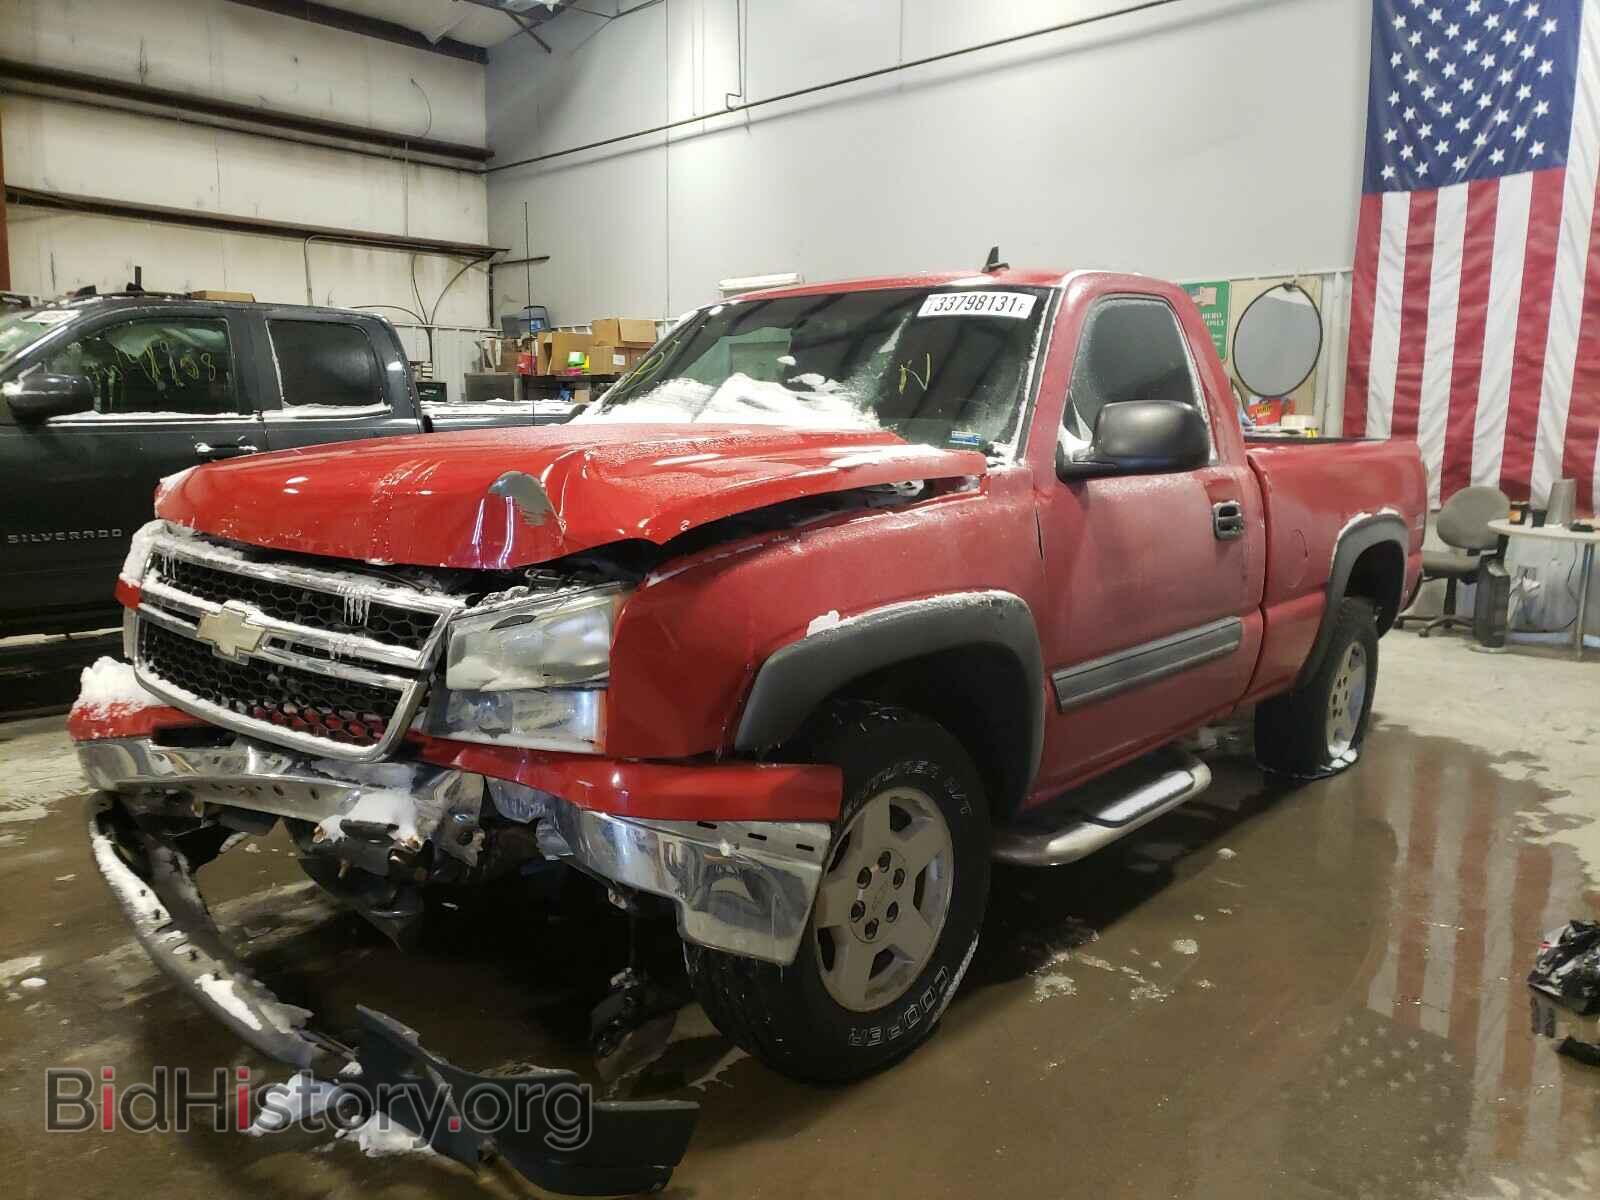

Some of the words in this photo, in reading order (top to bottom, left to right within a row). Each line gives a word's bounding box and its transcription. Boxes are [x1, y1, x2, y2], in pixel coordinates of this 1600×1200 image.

[934, 294, 1018, 313] 33798131
[7, 528, 122, 544] SILVERADO
[848, 965, 950, 1047] COOPER
